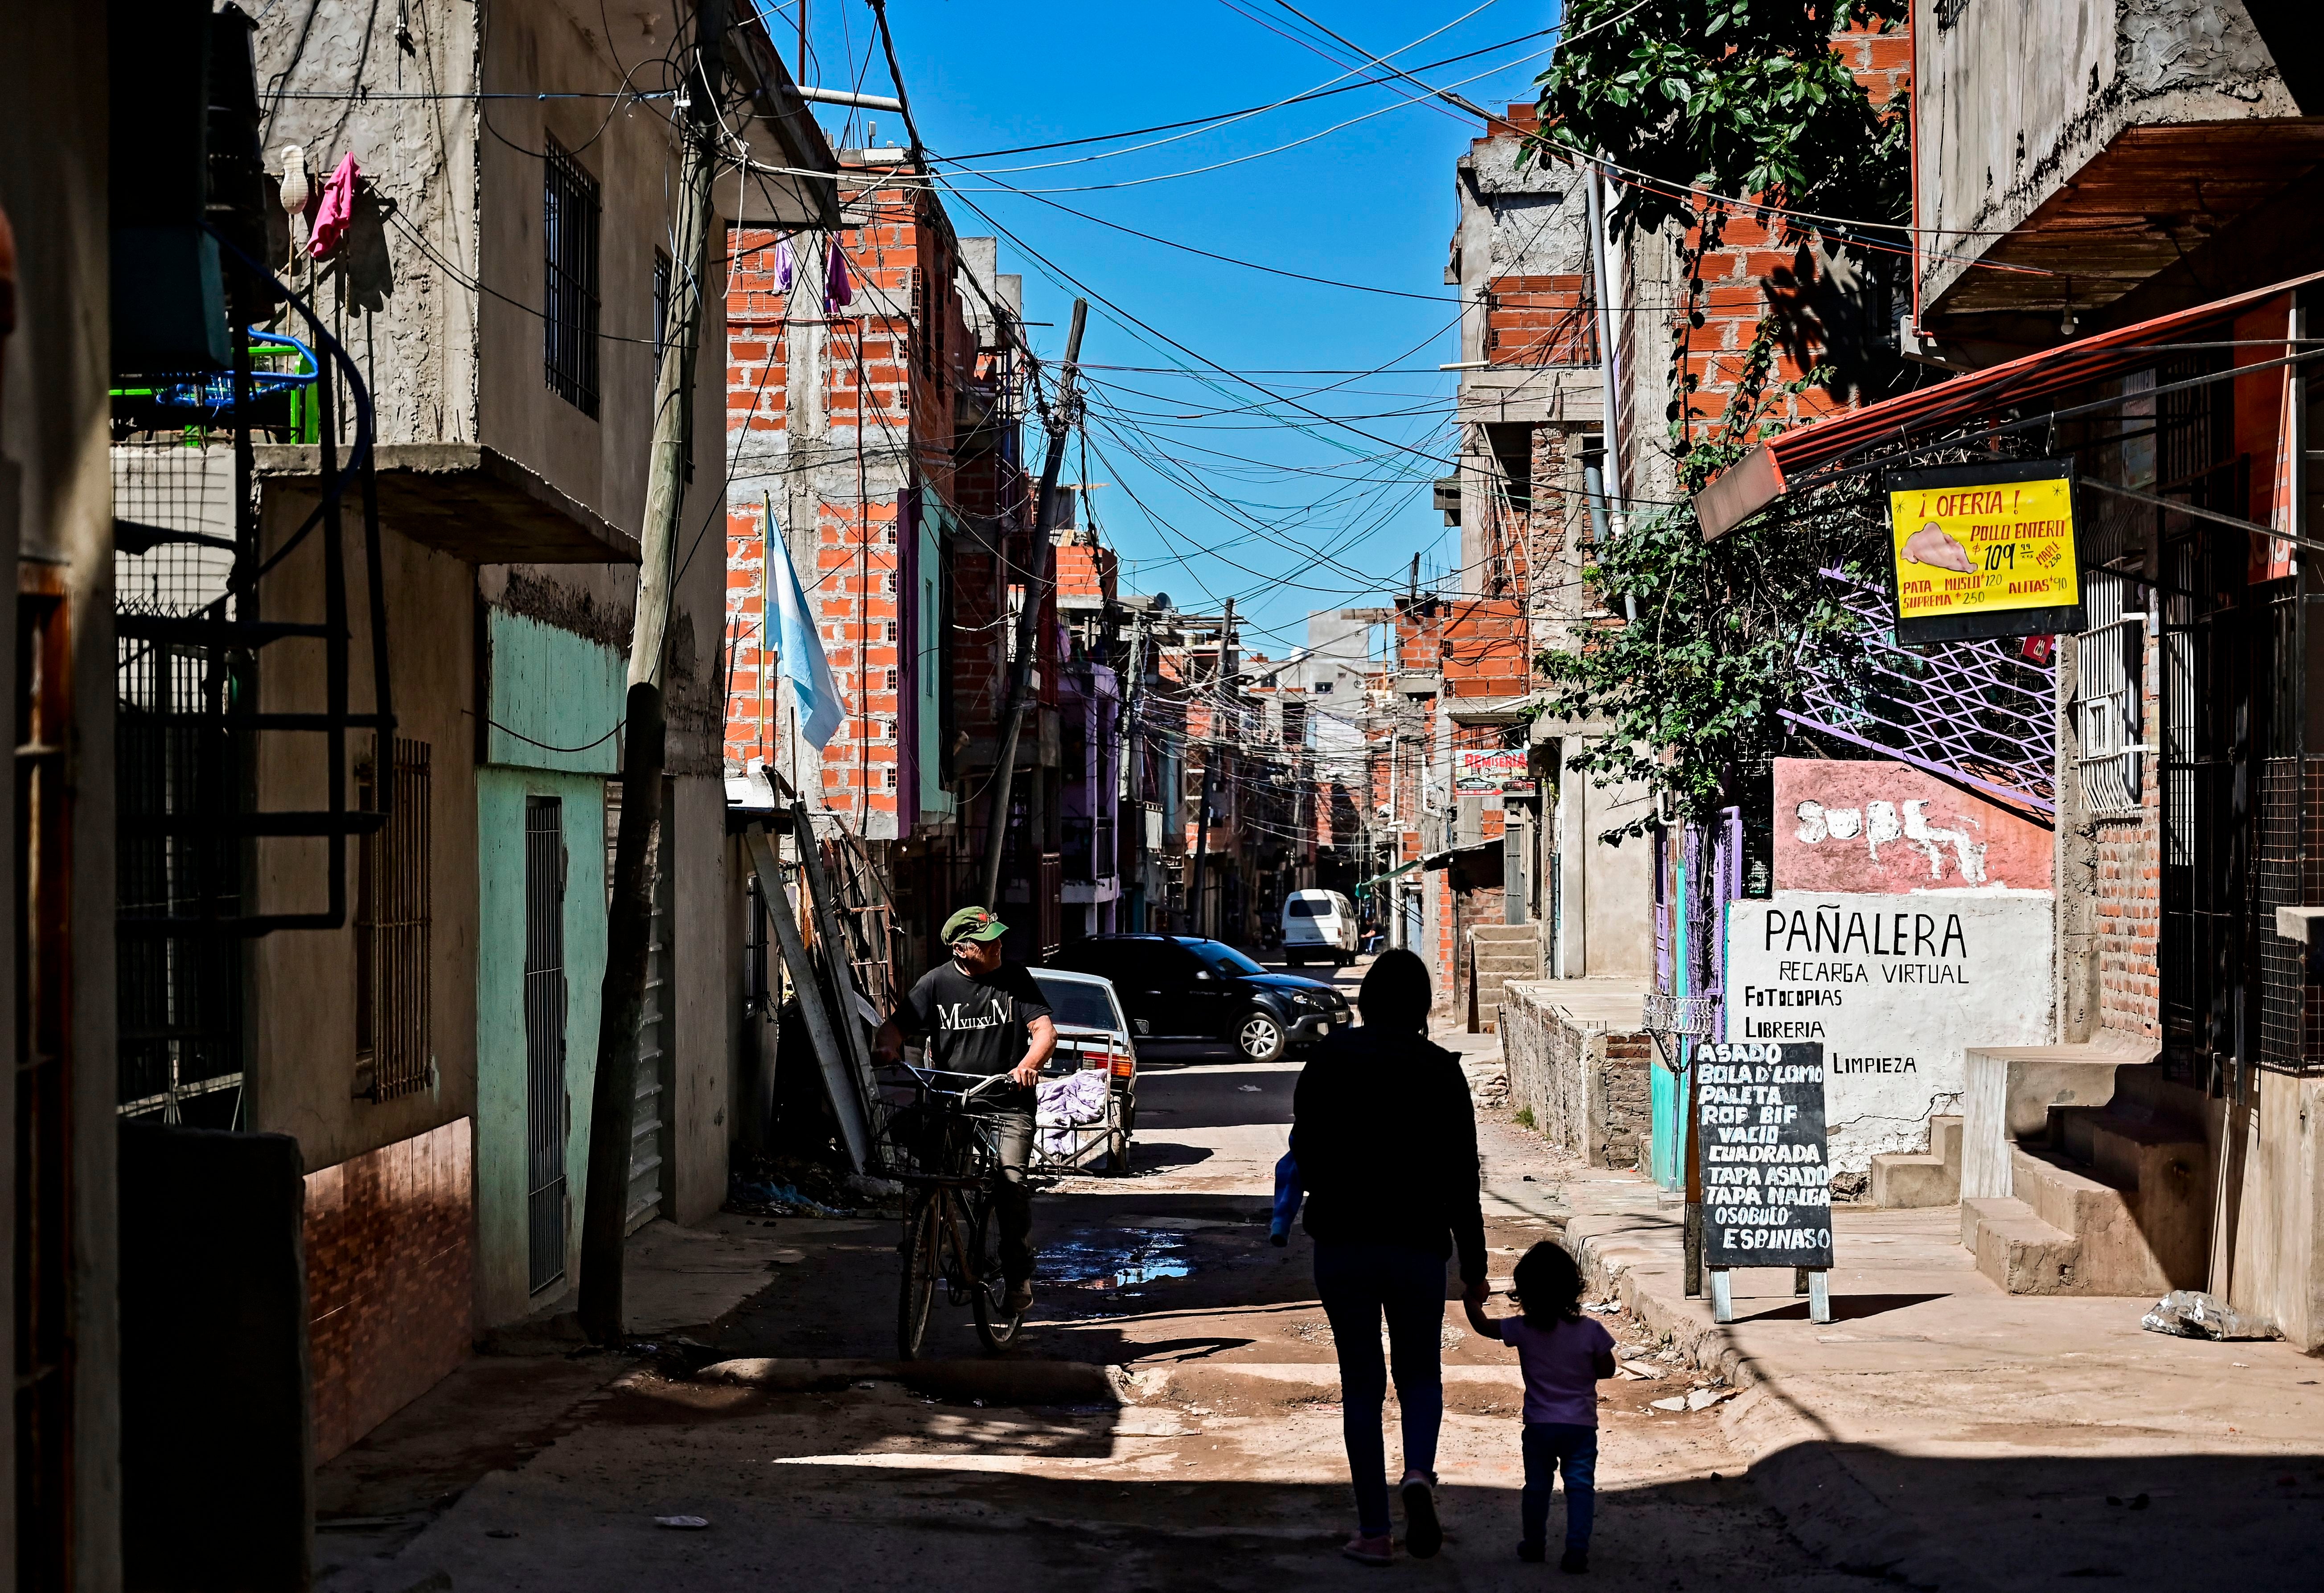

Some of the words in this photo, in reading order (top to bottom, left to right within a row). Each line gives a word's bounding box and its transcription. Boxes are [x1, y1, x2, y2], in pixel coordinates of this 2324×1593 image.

[1970, 525, 2011, 542] POLLO
[2015, 520, 2065, 539] ENTERO
[2036, 540, 2061, 566] MAPLE
[1903, 580, 1932, 594] PATA
[1945, 575, 1980, 591] MUSLO
[2008, 579, 2049, 594] ALITAS
[1903, 594, 1952, 609] SUPREMA
[1465, 752, 1527, 768] REMISERIA
[1766, 904, 1967, 958] PAÑALERA
[1779, 961, 1868, 983] RECARGA
[1881, 963, 1970, 984] VIRTUAL
[1745, 985, 1842, 1007] FOTOCOPIAS
[1745, 1017, 1825, 1038] LIBRERIA
[1697, 1043, 1782, 1065] ASADO
[1833, 1052, 1917, 1074] LIMPIEZA
[1697, 1063, 1753, 1084] BOLA
[1698, 1085, 1783, 1105] PALETA
[1759, 1104, 1798, 1124] BIF
[1717, 1125, 1779, 1144] VACIO
[1708, 1144, 1821, 1163] CUADRADA
[1707, 1166, 1761, 1185] TAPA
[1764, 1164, 1829, 1187] ASADO
[1706, 1186, 1762, 1206] TAPA
[1723, 1228, 1831, 1249] ESPINASO
